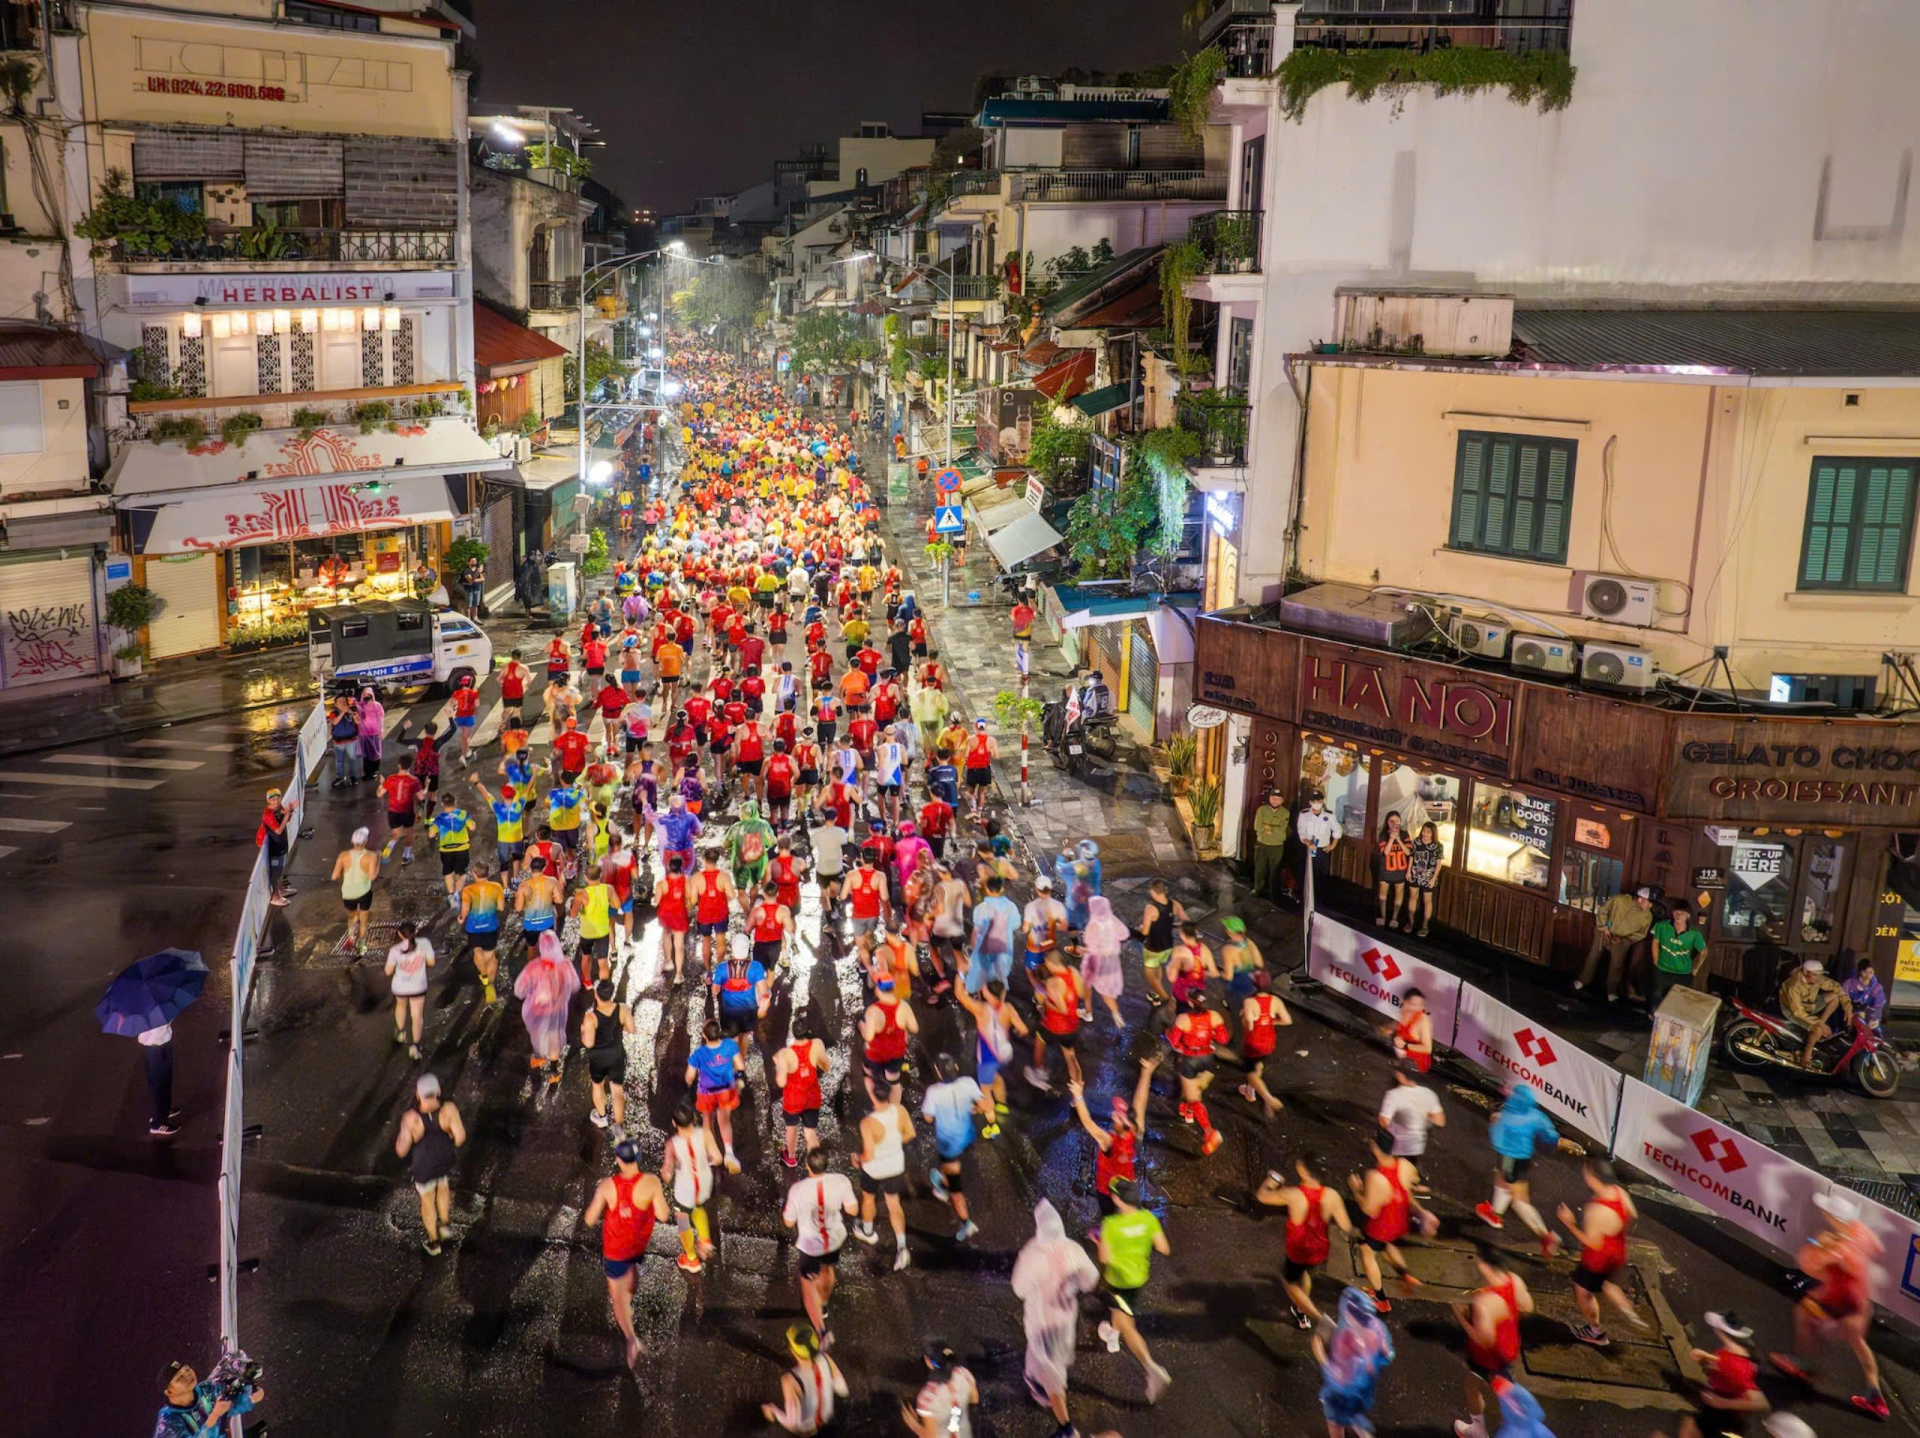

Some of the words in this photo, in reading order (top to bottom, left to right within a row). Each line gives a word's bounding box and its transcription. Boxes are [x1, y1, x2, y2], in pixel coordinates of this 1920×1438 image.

[222, 286, 374, 302] HERBALIST
[1682, 741, 1821, 768] GELATO
[1710, 776, 1920, 808] CROISSANT
[1520, 797, 1551, 812] SLIDE
[1517, 808, 1549, 825] DOOR
[1533, 825, 1548, 836] TO
[1510, 832, 1546, 849] ORDER
[1701, 869, 1718, 877] 113
[1734, 859, 1781, 873] HERE
[1328, 963, 1431, 1016] TECHCOMB
[1476, 1040, 1588, 1118] TECHCOMBANK
[1643, 1142, 1788, 1233] TECHCOMBANK
